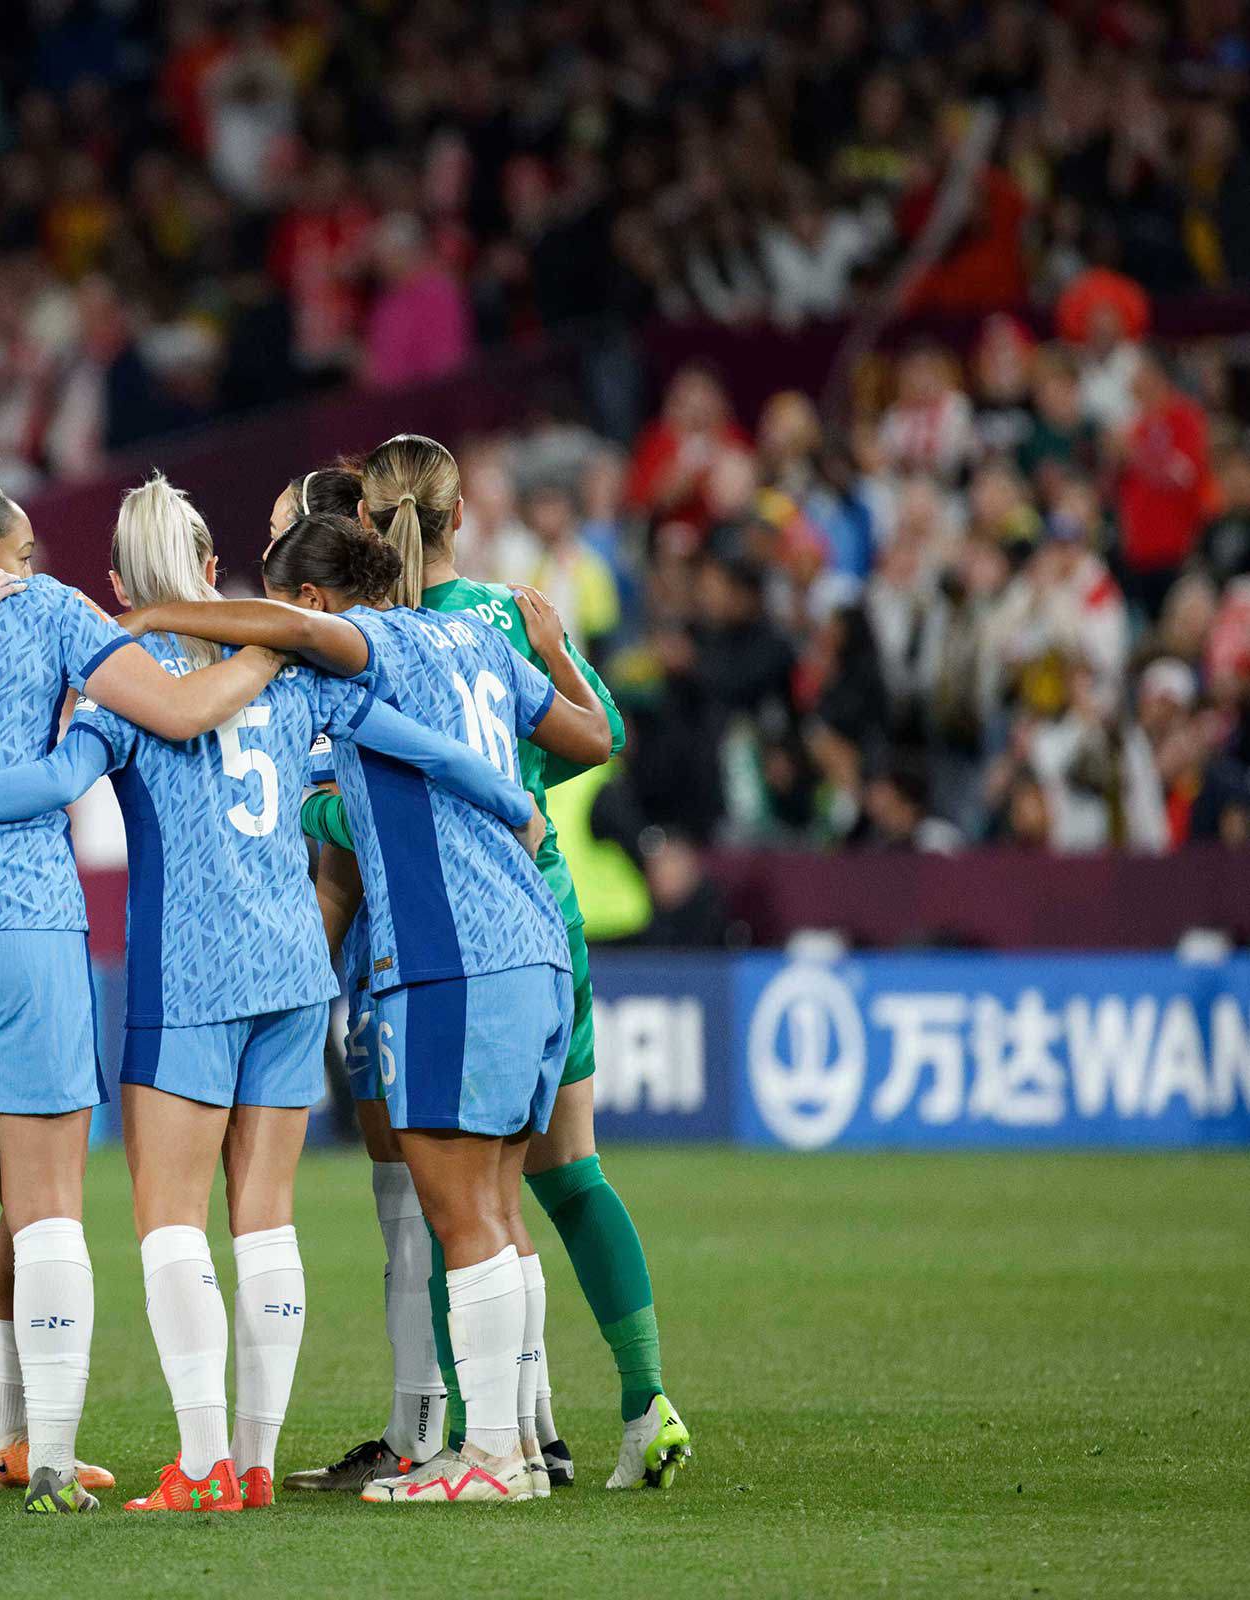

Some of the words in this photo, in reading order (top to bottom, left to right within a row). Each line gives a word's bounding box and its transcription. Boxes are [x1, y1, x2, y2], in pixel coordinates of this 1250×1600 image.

[214, 705, 279, 838] 5
[452, 669, 515, 785] 16
[870, 990, 1066, 1125] 万达
